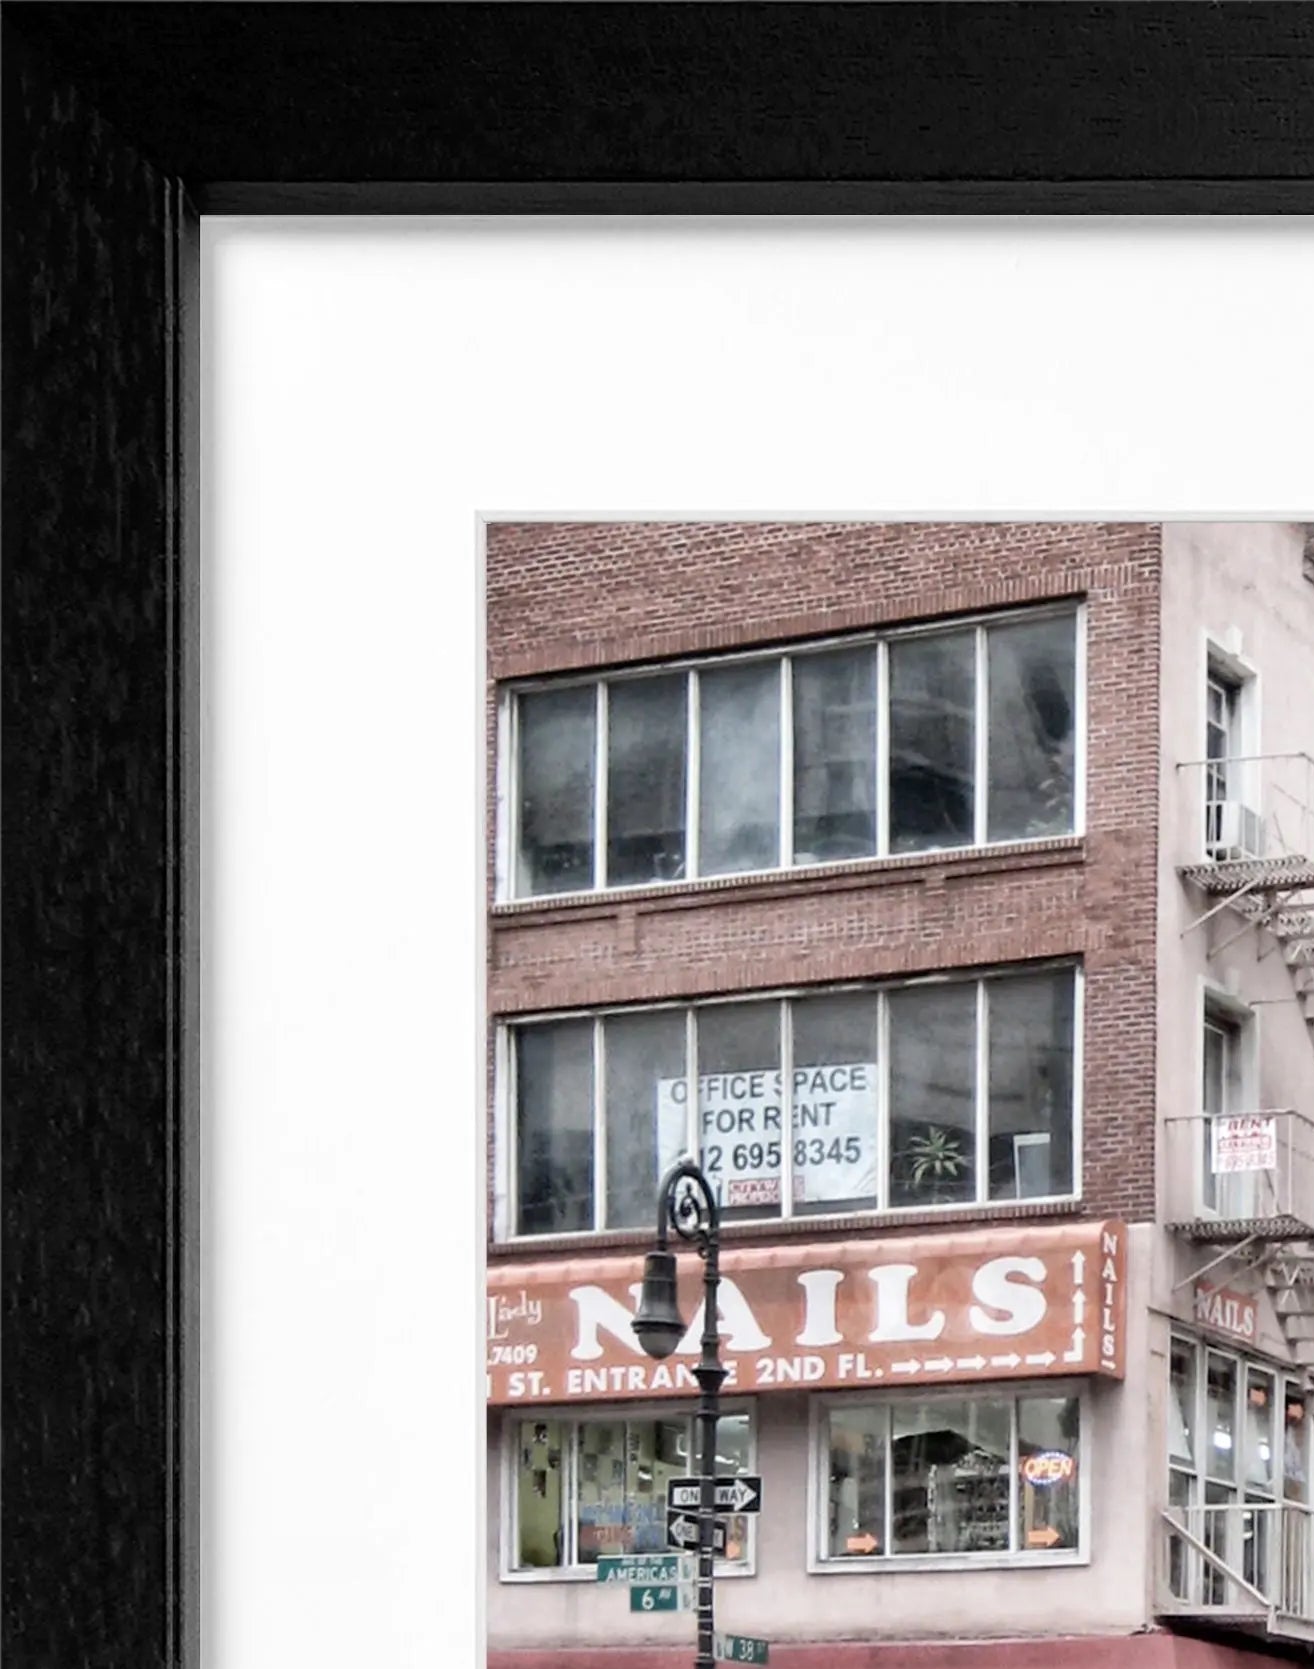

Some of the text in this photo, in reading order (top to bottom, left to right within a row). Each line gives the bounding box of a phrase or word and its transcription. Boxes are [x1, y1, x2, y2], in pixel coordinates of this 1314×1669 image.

[702, 1109, 756, 1135] FOR
[733, 1142, 781, 1171] 695
[793, 1136, 861, 1167] 8345
[569, 1257, 1047, 1360] NAILS
[1102, 1233, 1118, 1356] NAILS
[487, 1289, 542, 1340] Lady
[1196, 1288, 1255, 1336] NAILS
[508, 1371, 552, 1398] ST.
[567, 1361, 738, 1395] ENTRANE
[756, 1357, 826, 1384] 2ND
[838, 1353, 884, 1379] FL.
[1025, 1457, 1073, 1479] OPEN
[680, 1487, 747, 1504] ON WAY
[605, 1566, 678, 1584] AMERICAS
[641, 1589, 655, 1610] 6
[739, 1640, 754, 1661] 38
